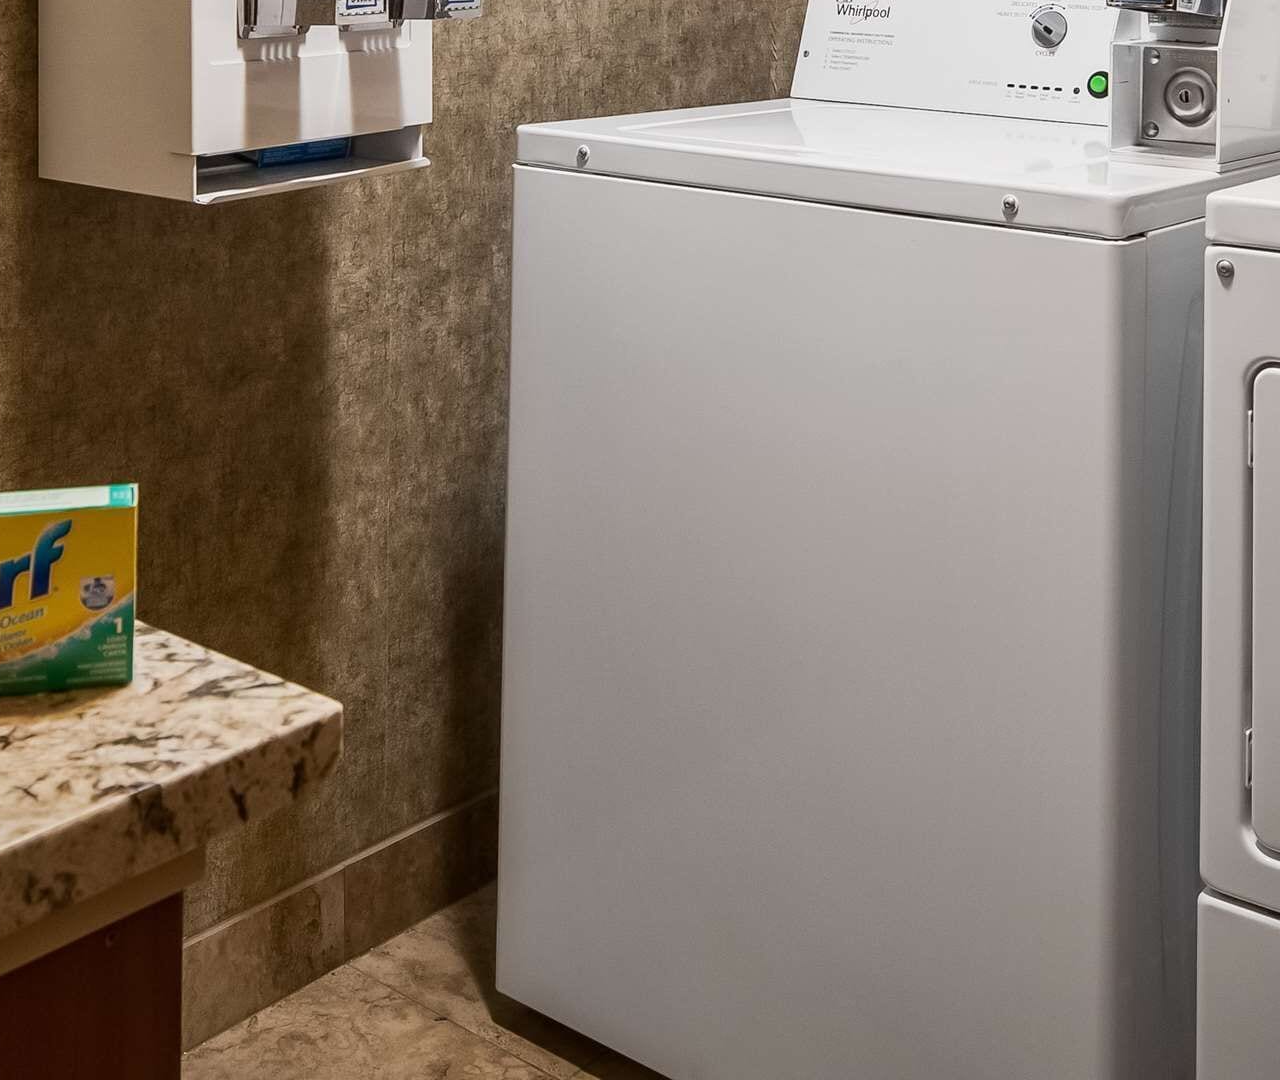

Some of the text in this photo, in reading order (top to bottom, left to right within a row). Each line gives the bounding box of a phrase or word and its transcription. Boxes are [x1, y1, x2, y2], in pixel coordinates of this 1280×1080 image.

[837, 3, 891, 21] Whirlpool
[0, 607, 45, 631] Ocean
[113, 617, 123, 633] 1
